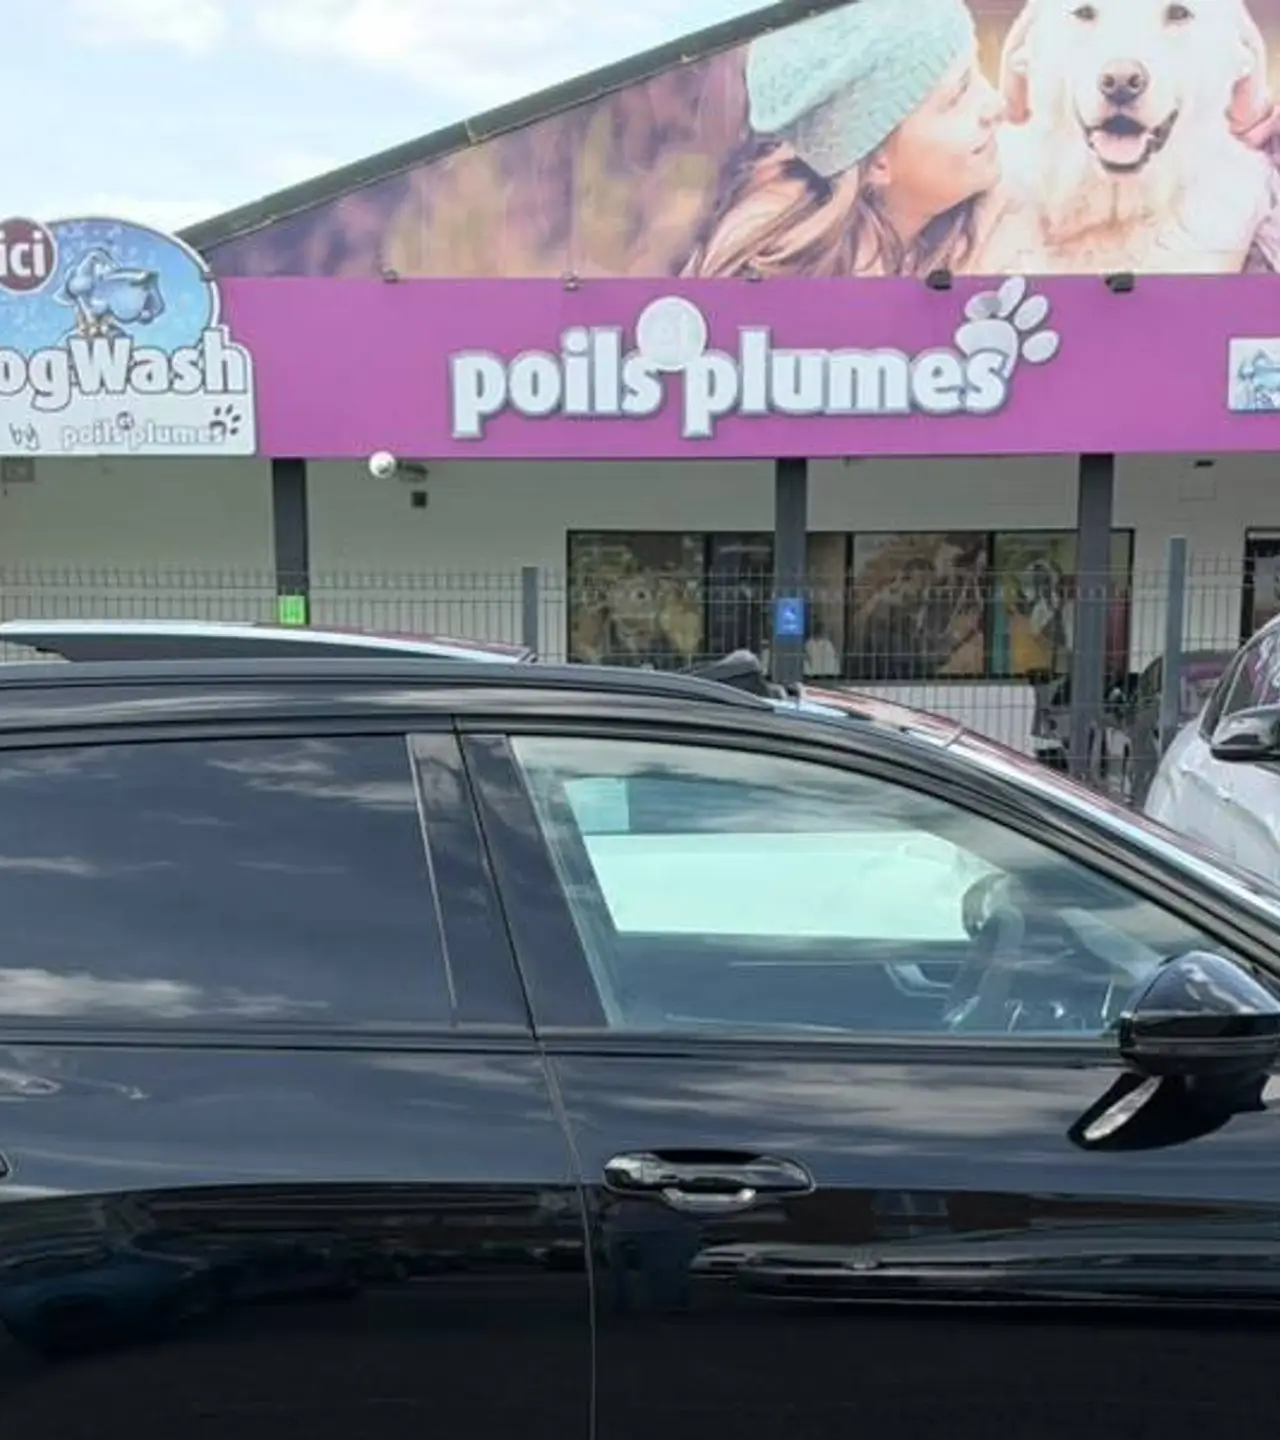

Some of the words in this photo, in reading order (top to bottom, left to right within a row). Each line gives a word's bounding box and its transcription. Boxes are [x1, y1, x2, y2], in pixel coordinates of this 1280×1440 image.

[450, 325, 662, 439] poils
[681, 325, 1008, 439] plumes
[8, 422, 40, 450] by
